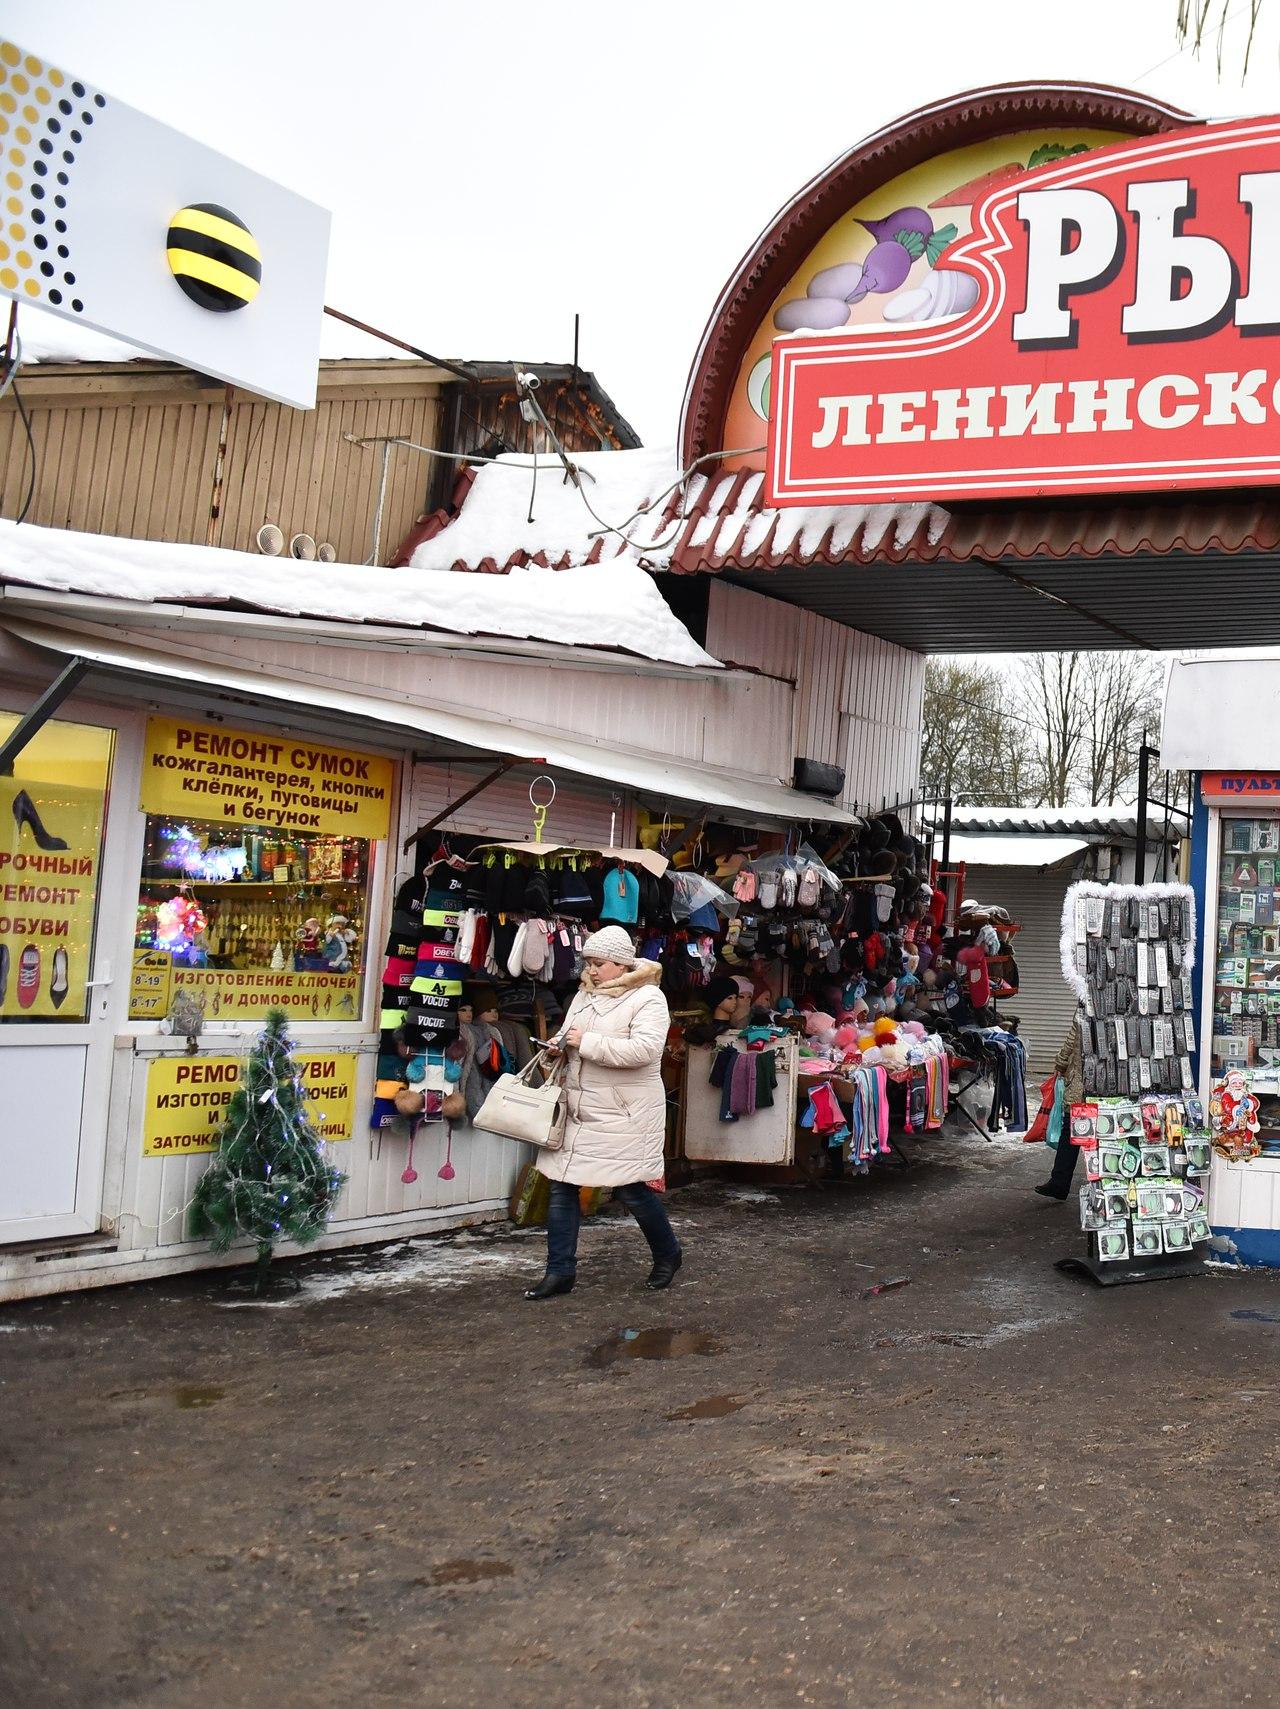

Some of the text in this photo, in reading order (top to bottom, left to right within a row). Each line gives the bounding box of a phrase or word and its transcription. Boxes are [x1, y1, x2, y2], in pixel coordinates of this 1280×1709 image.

[176, 728, 370, 779] РЕМОНТ СУМОК
[152, 753, 385, 800] кожгалантерея, кнопки
[182, 776, 359, 814] клёпки, пуговицы
[223, 802, 320, 827] и бегунок
[0, 884, 81, 905] ЕМОНТ
[0, 916, 69, 937] ОБУВИ
[174, 971, 357, 989] ИЗГОТОВЛЕНИЕ КЛЮЧЕЙ
[223, 993, 310, 1007] И ДОМОФОН
[422, 995, 450, 1008] VOGUE
[417, 1015, 446, 1028] VOGUE
[176, 1061, 336, 1084] РЕМО УВИ
[156, 1083, 348, 1108] ИЗГОТОВ ЮЧЕЙ
[208, 1111, 219, 1124] И
